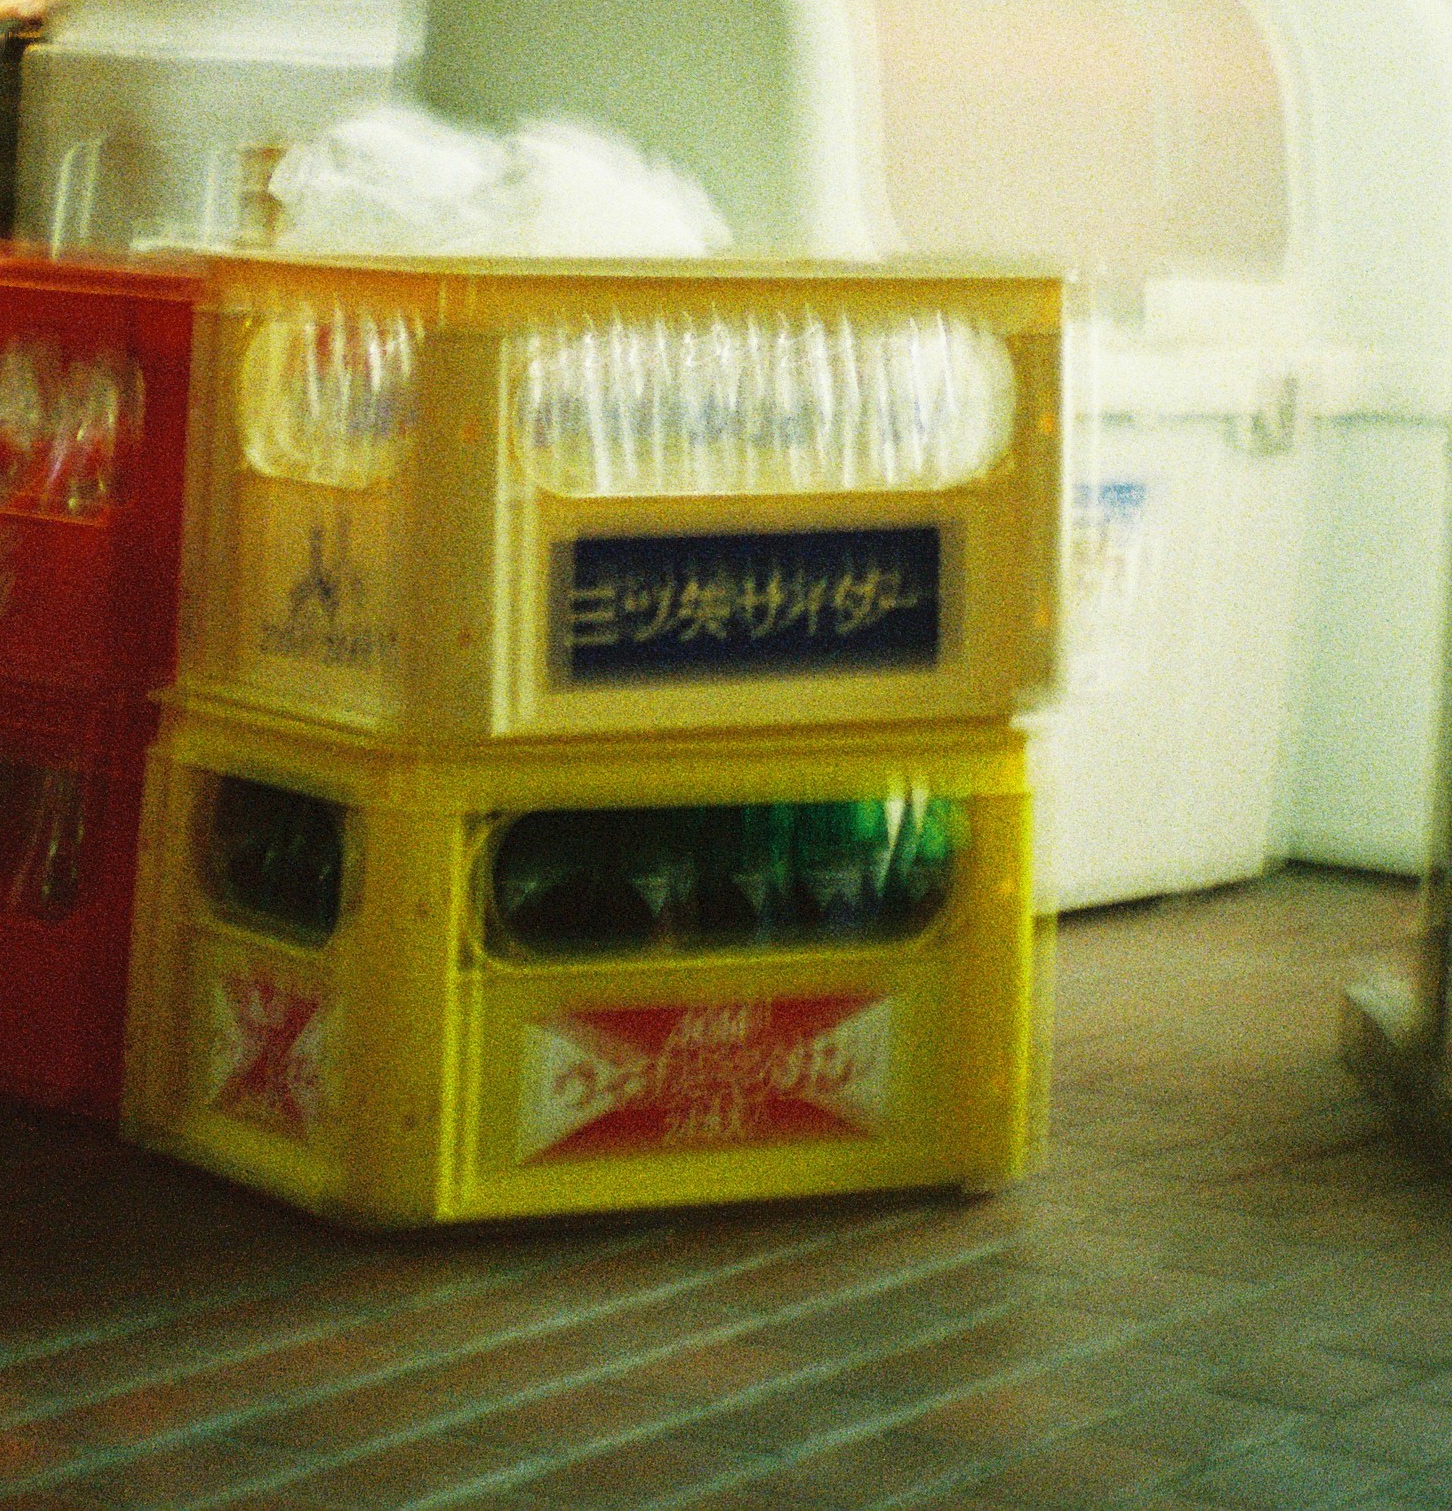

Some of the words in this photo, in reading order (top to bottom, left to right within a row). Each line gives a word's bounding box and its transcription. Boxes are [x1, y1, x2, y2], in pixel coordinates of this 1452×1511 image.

[565, 566, 926, 646] 三ツ矢サイダー
